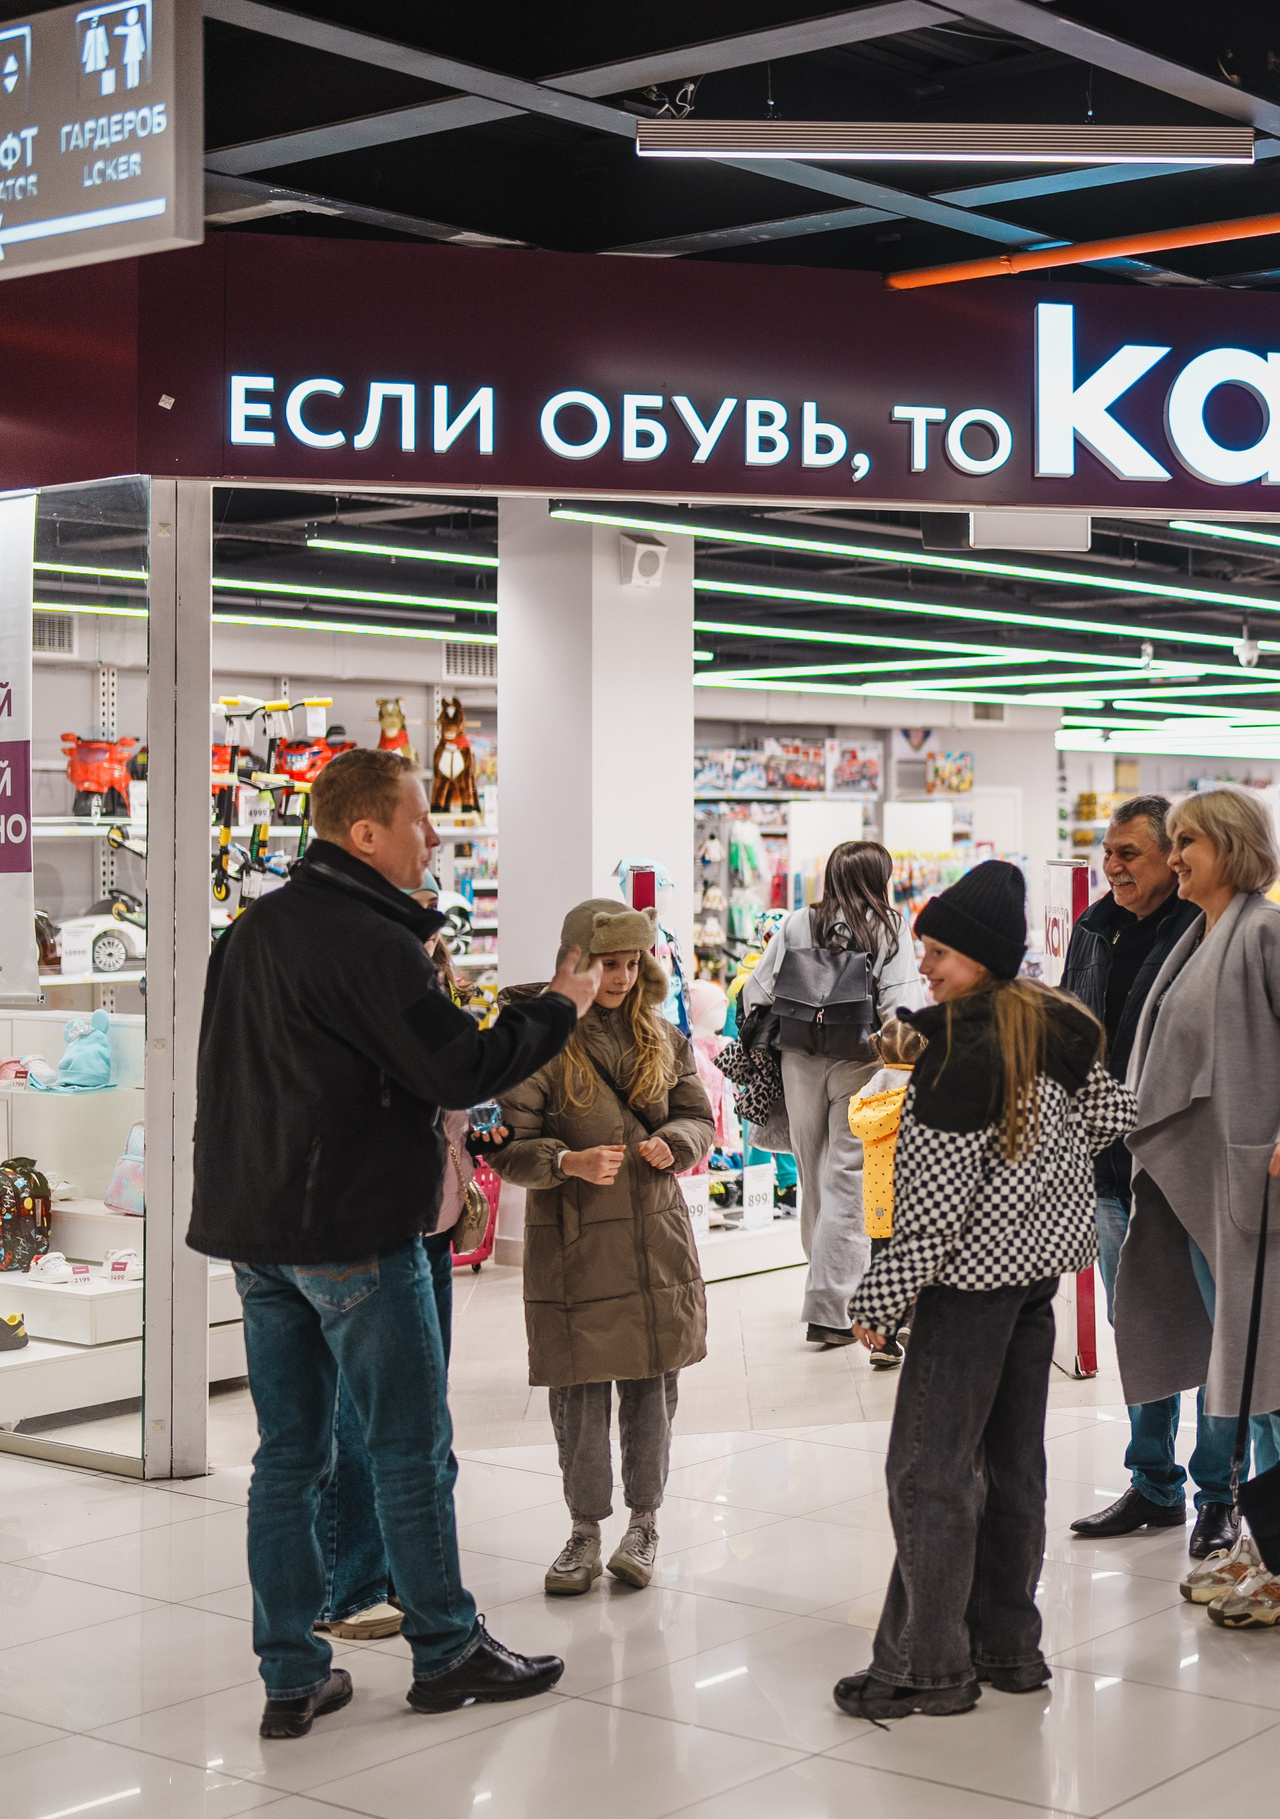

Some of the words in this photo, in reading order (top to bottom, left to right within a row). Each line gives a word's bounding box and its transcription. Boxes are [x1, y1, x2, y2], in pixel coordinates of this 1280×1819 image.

[60, 102, 168, 153] ГАРДЕРОБ
[230, 375, 494, 455] ЕСЛИ
[540, 390, 871, 482] ОБУВЬ,
[892, 405, 1013, 475] ТО
[1044, 905, 1070, 958] kari
[689, 1204, 704, 1218] 99
[74, 1276, 91, 1284] 2199
